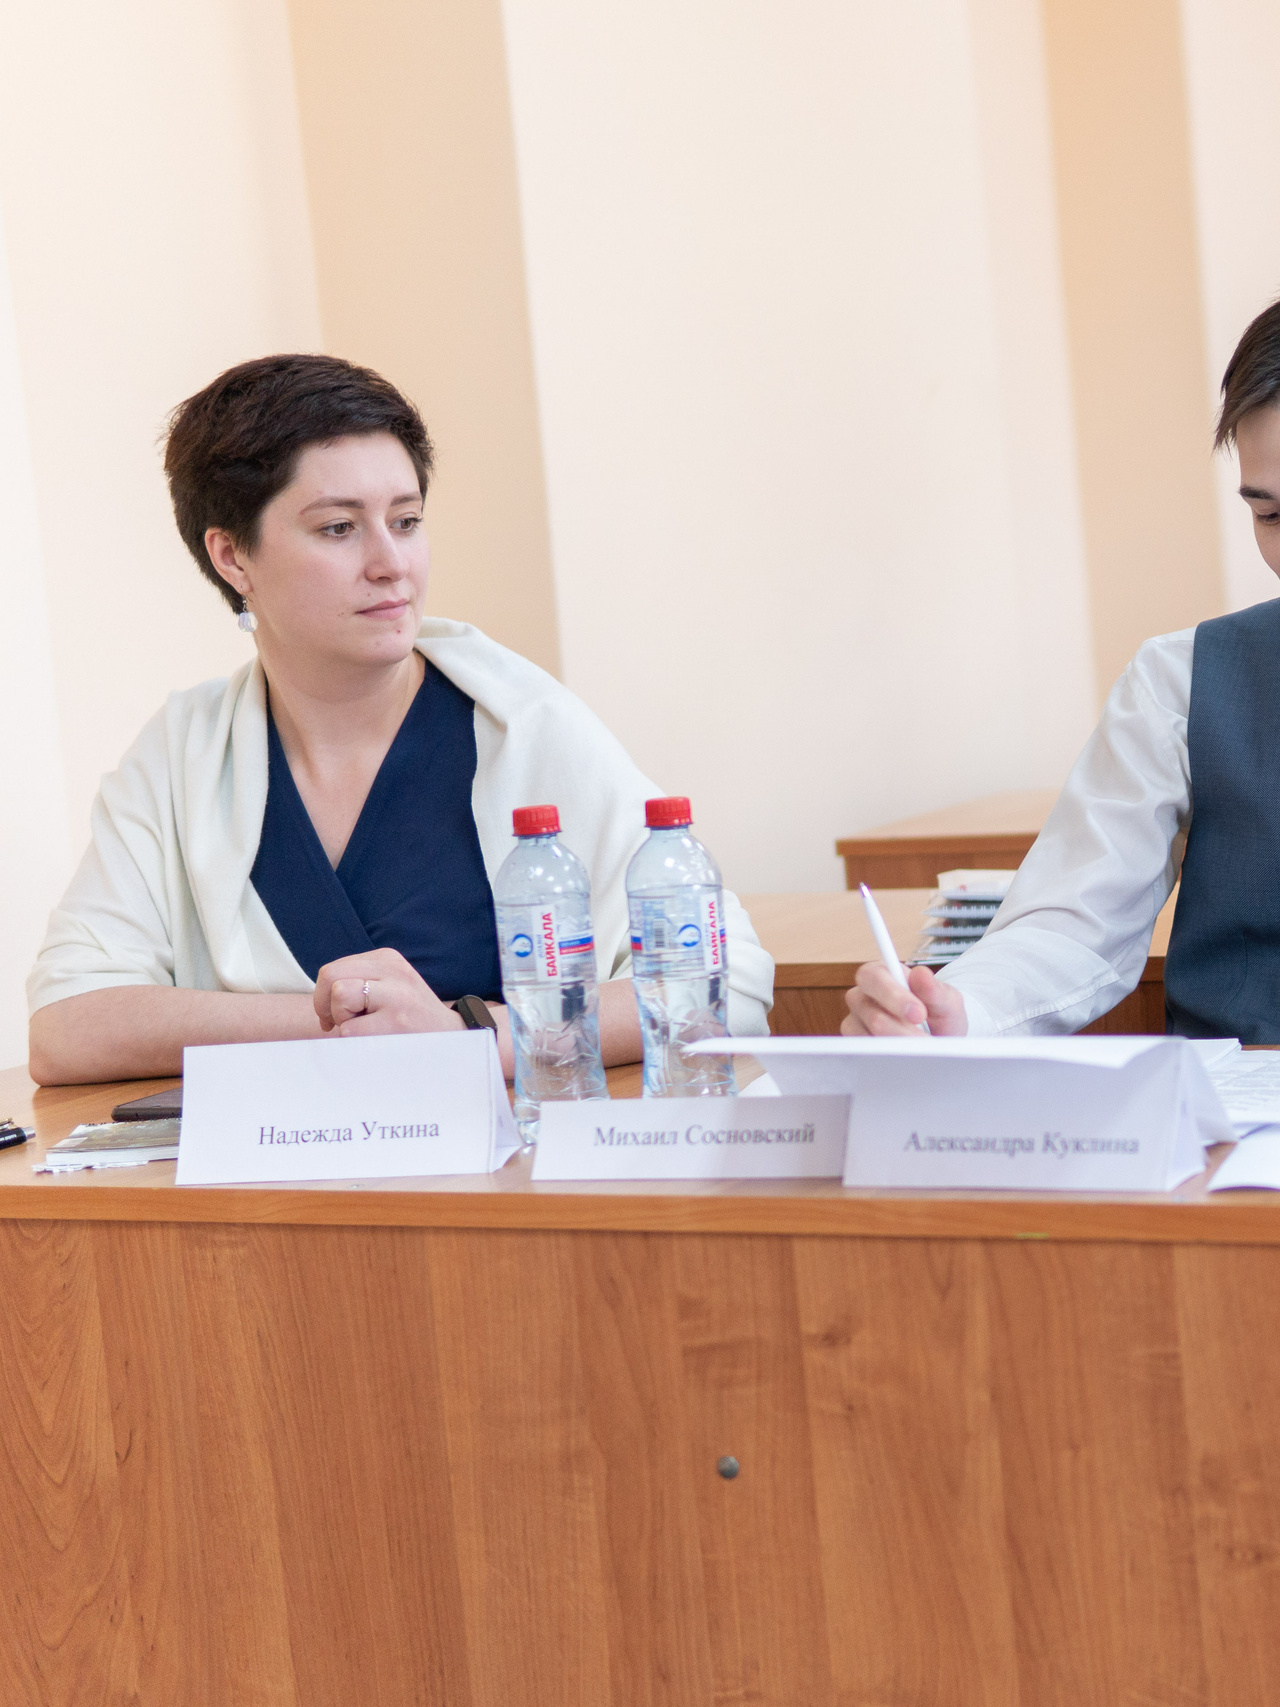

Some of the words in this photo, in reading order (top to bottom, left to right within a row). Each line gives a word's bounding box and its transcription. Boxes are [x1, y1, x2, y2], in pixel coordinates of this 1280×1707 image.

[542, 912, 558, 977] БАЙКАЛА
[258, 1126, 353, 1145] Надежда
[361, 1121, 440, 1140] Уткина
[593, 1126, 678, 1146] Михаил
[685, 1123, 815, 1145] Сосновский
[904, 1131, 1035, 1157] Александра
[1042, 1131, 1140, 1159] Куклина
